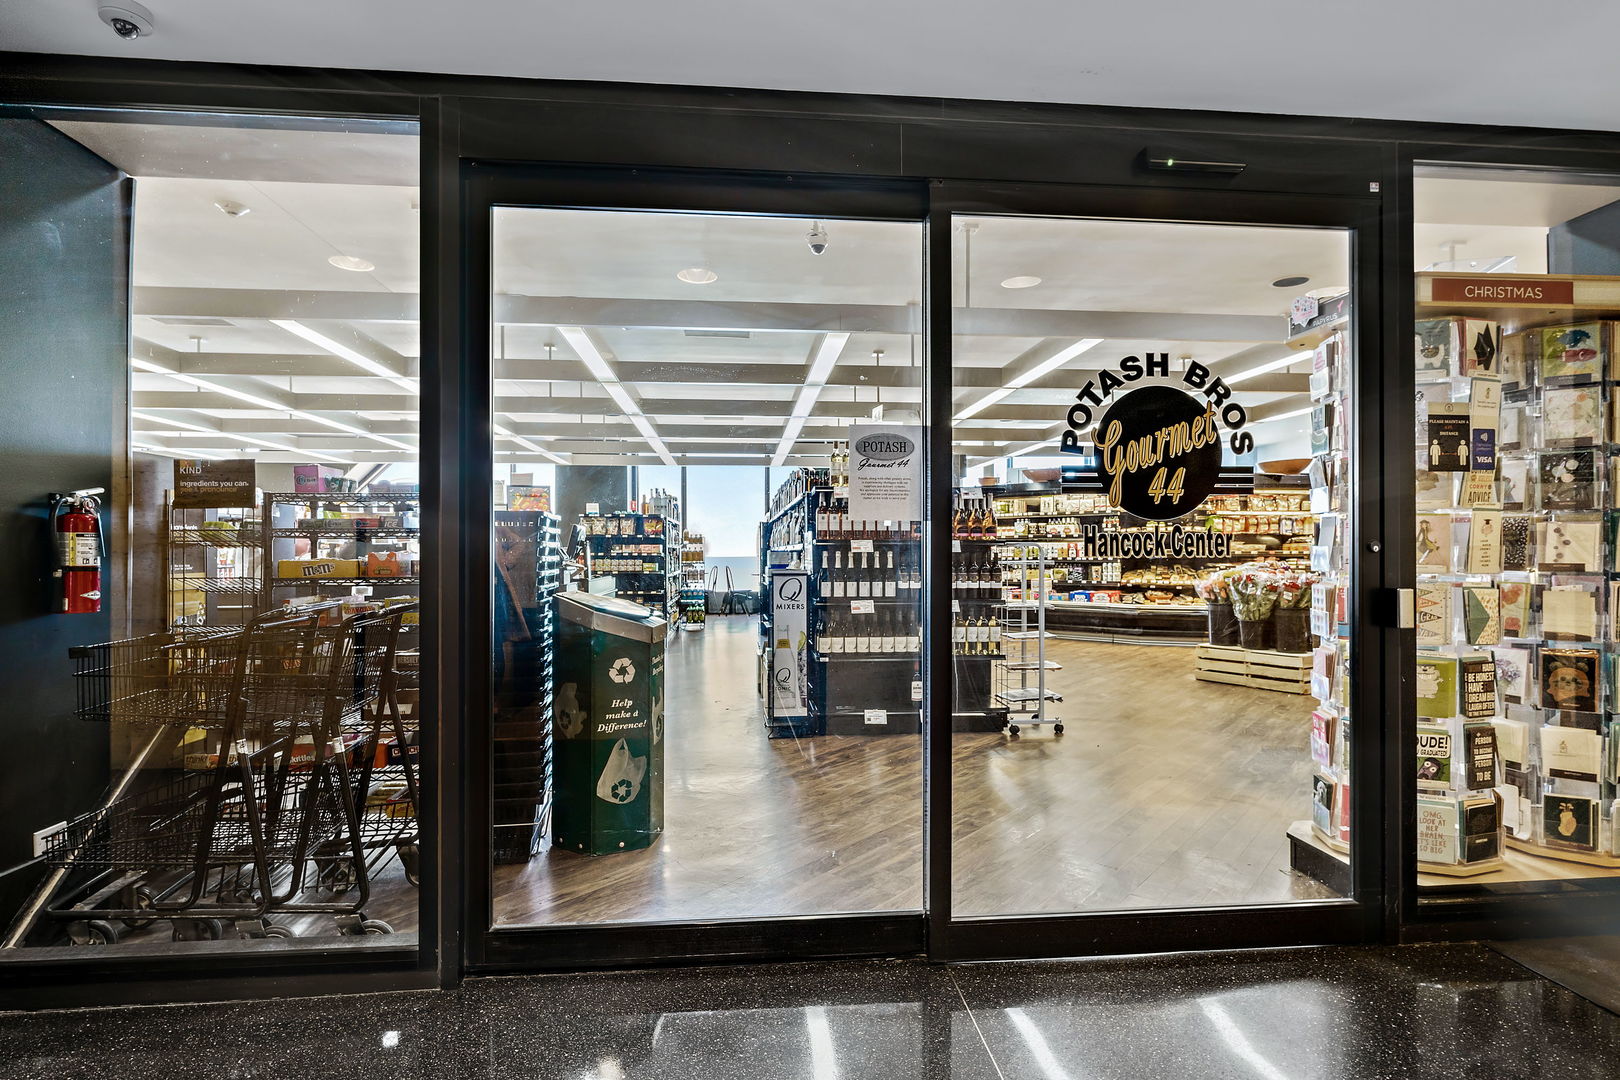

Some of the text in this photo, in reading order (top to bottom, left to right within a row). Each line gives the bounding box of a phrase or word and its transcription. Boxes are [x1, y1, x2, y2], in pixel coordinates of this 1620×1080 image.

[1464, 285, 1543, 299] CHRISTMAS
[1060, 352, 1255, 455] POTASH BROS
[863, 441, 907, 453] POTASH
[1090, 400, 1217, 508] Gourmet
[857, 458, 896, 471] Gourmet
[180, 467, 202, 475] KIND
[180, 480, 218, 488] ingredients
[1148, 467, 1186, 505] 44
[1468, 491, 1491, 504] ADVICE
[1083, 524, 1234, 559] Hancock Center
[779, 578, 802, 602] Q
[776, 668, 791, 686] Q
[1468, 672, 1494, 682] BE HONEST
[1468, 682, 1484, 692] HAVE
[611, 699, 632, 708] Help
[1469, 693, 1486, 702] DREAM
[605, 711, 631, 720] make
[597, 720, 647, 733] Difference!
[1421, 749, 1447, 757] GRADUATED!
[1476, 771, 1491, 781] TO BE
[1419, 817, 1435, 825] LOOK
